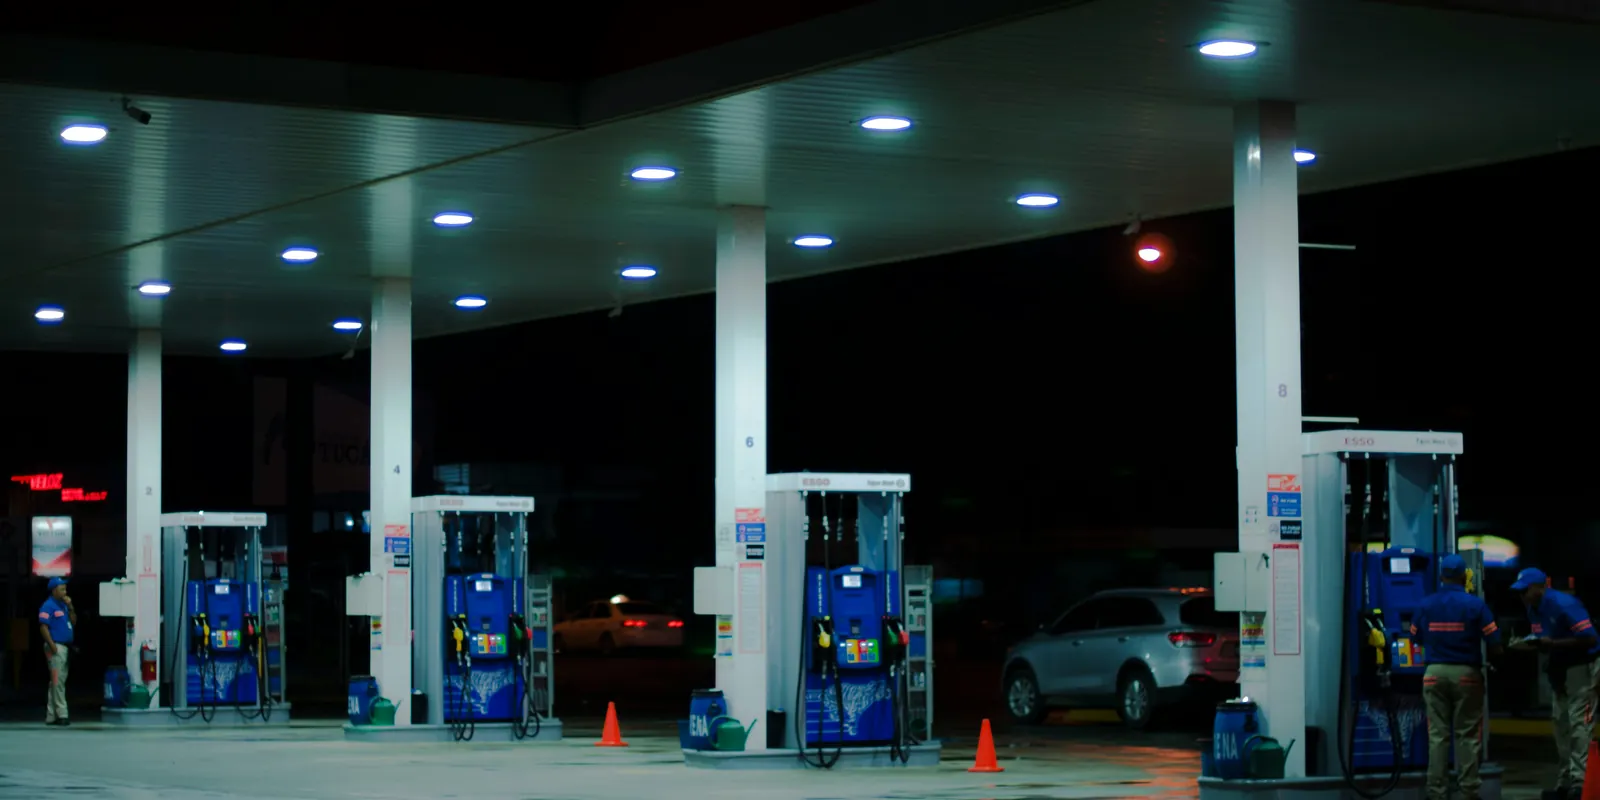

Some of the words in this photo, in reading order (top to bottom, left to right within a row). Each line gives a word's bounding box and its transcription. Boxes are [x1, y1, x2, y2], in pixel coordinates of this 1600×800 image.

[1277, 383, 1288, 398] 8
[745, 436, 755, 448] 6
[1343, 436, 1375, 447] ESSO
[393, 464, 401, 475] 4
[145, 486, 153, 496] 2
[689, 713, 709, 737] ENA
[1214, 732, 1239, 760] ENA
